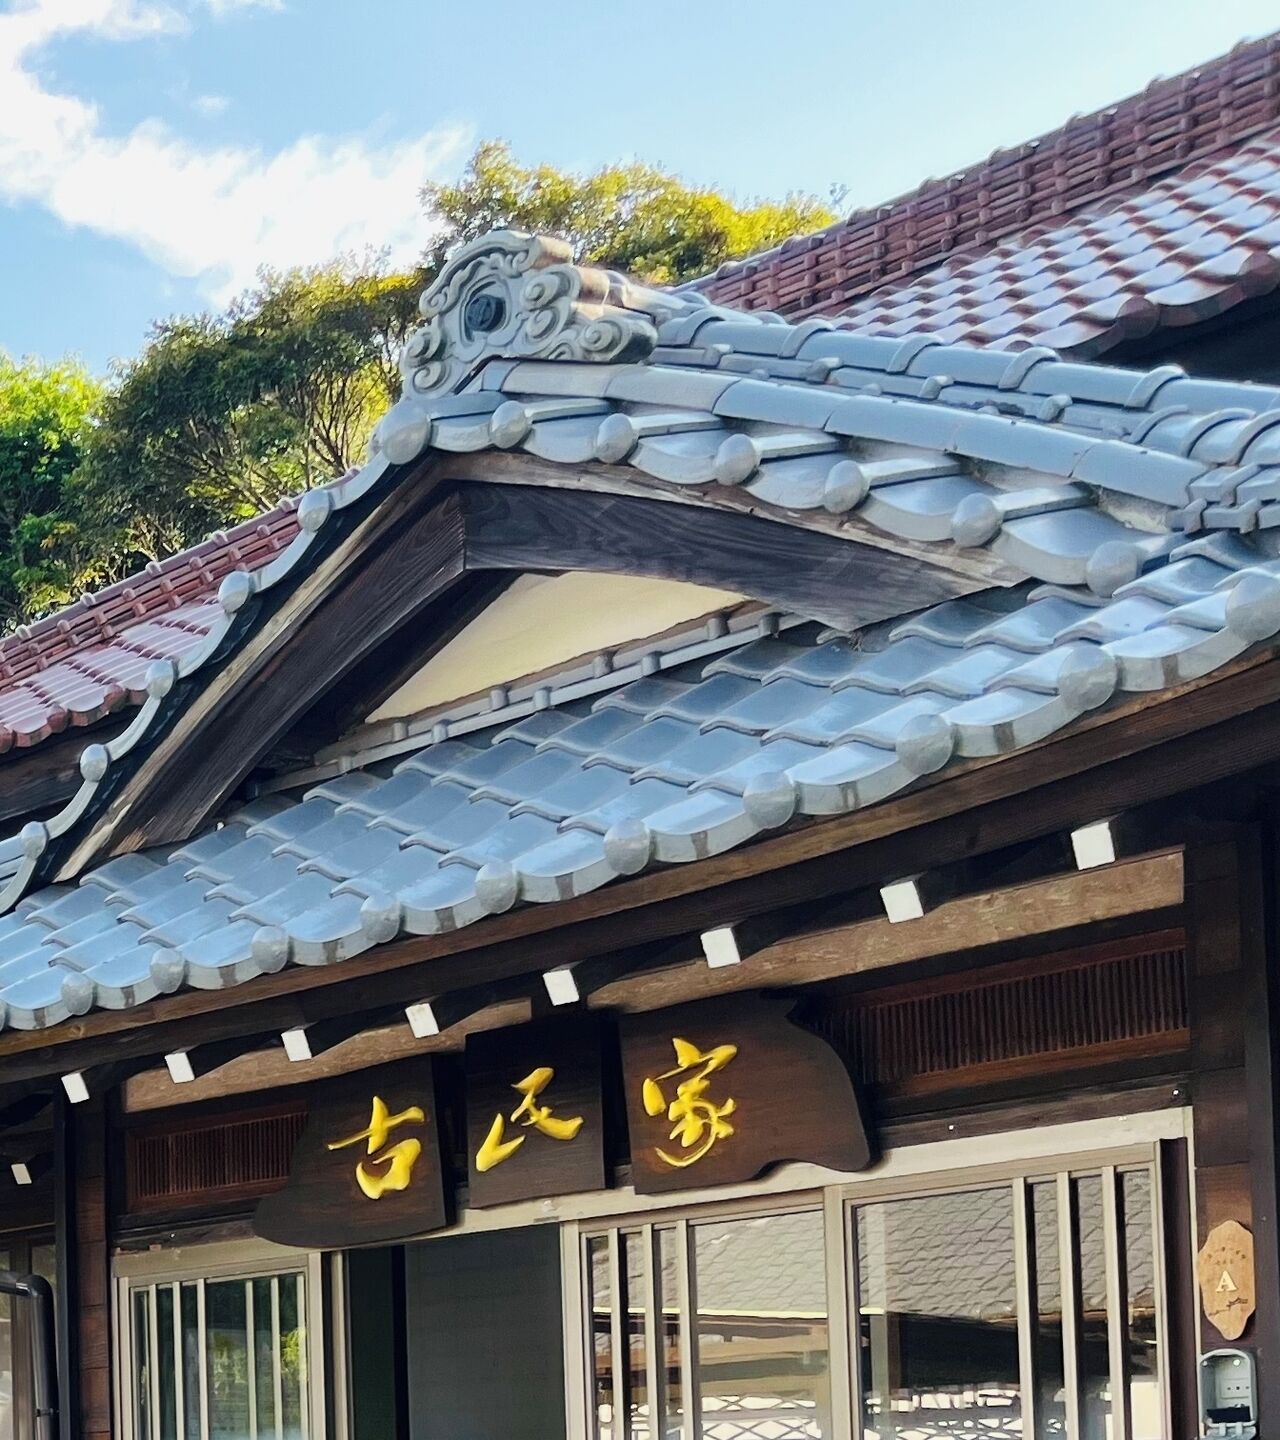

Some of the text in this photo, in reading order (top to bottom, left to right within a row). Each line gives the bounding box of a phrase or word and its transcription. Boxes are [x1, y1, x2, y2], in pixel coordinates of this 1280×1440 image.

[327, 1036, 738, 1200] 古民家
[1215, 1269, 1238, 1292] A
